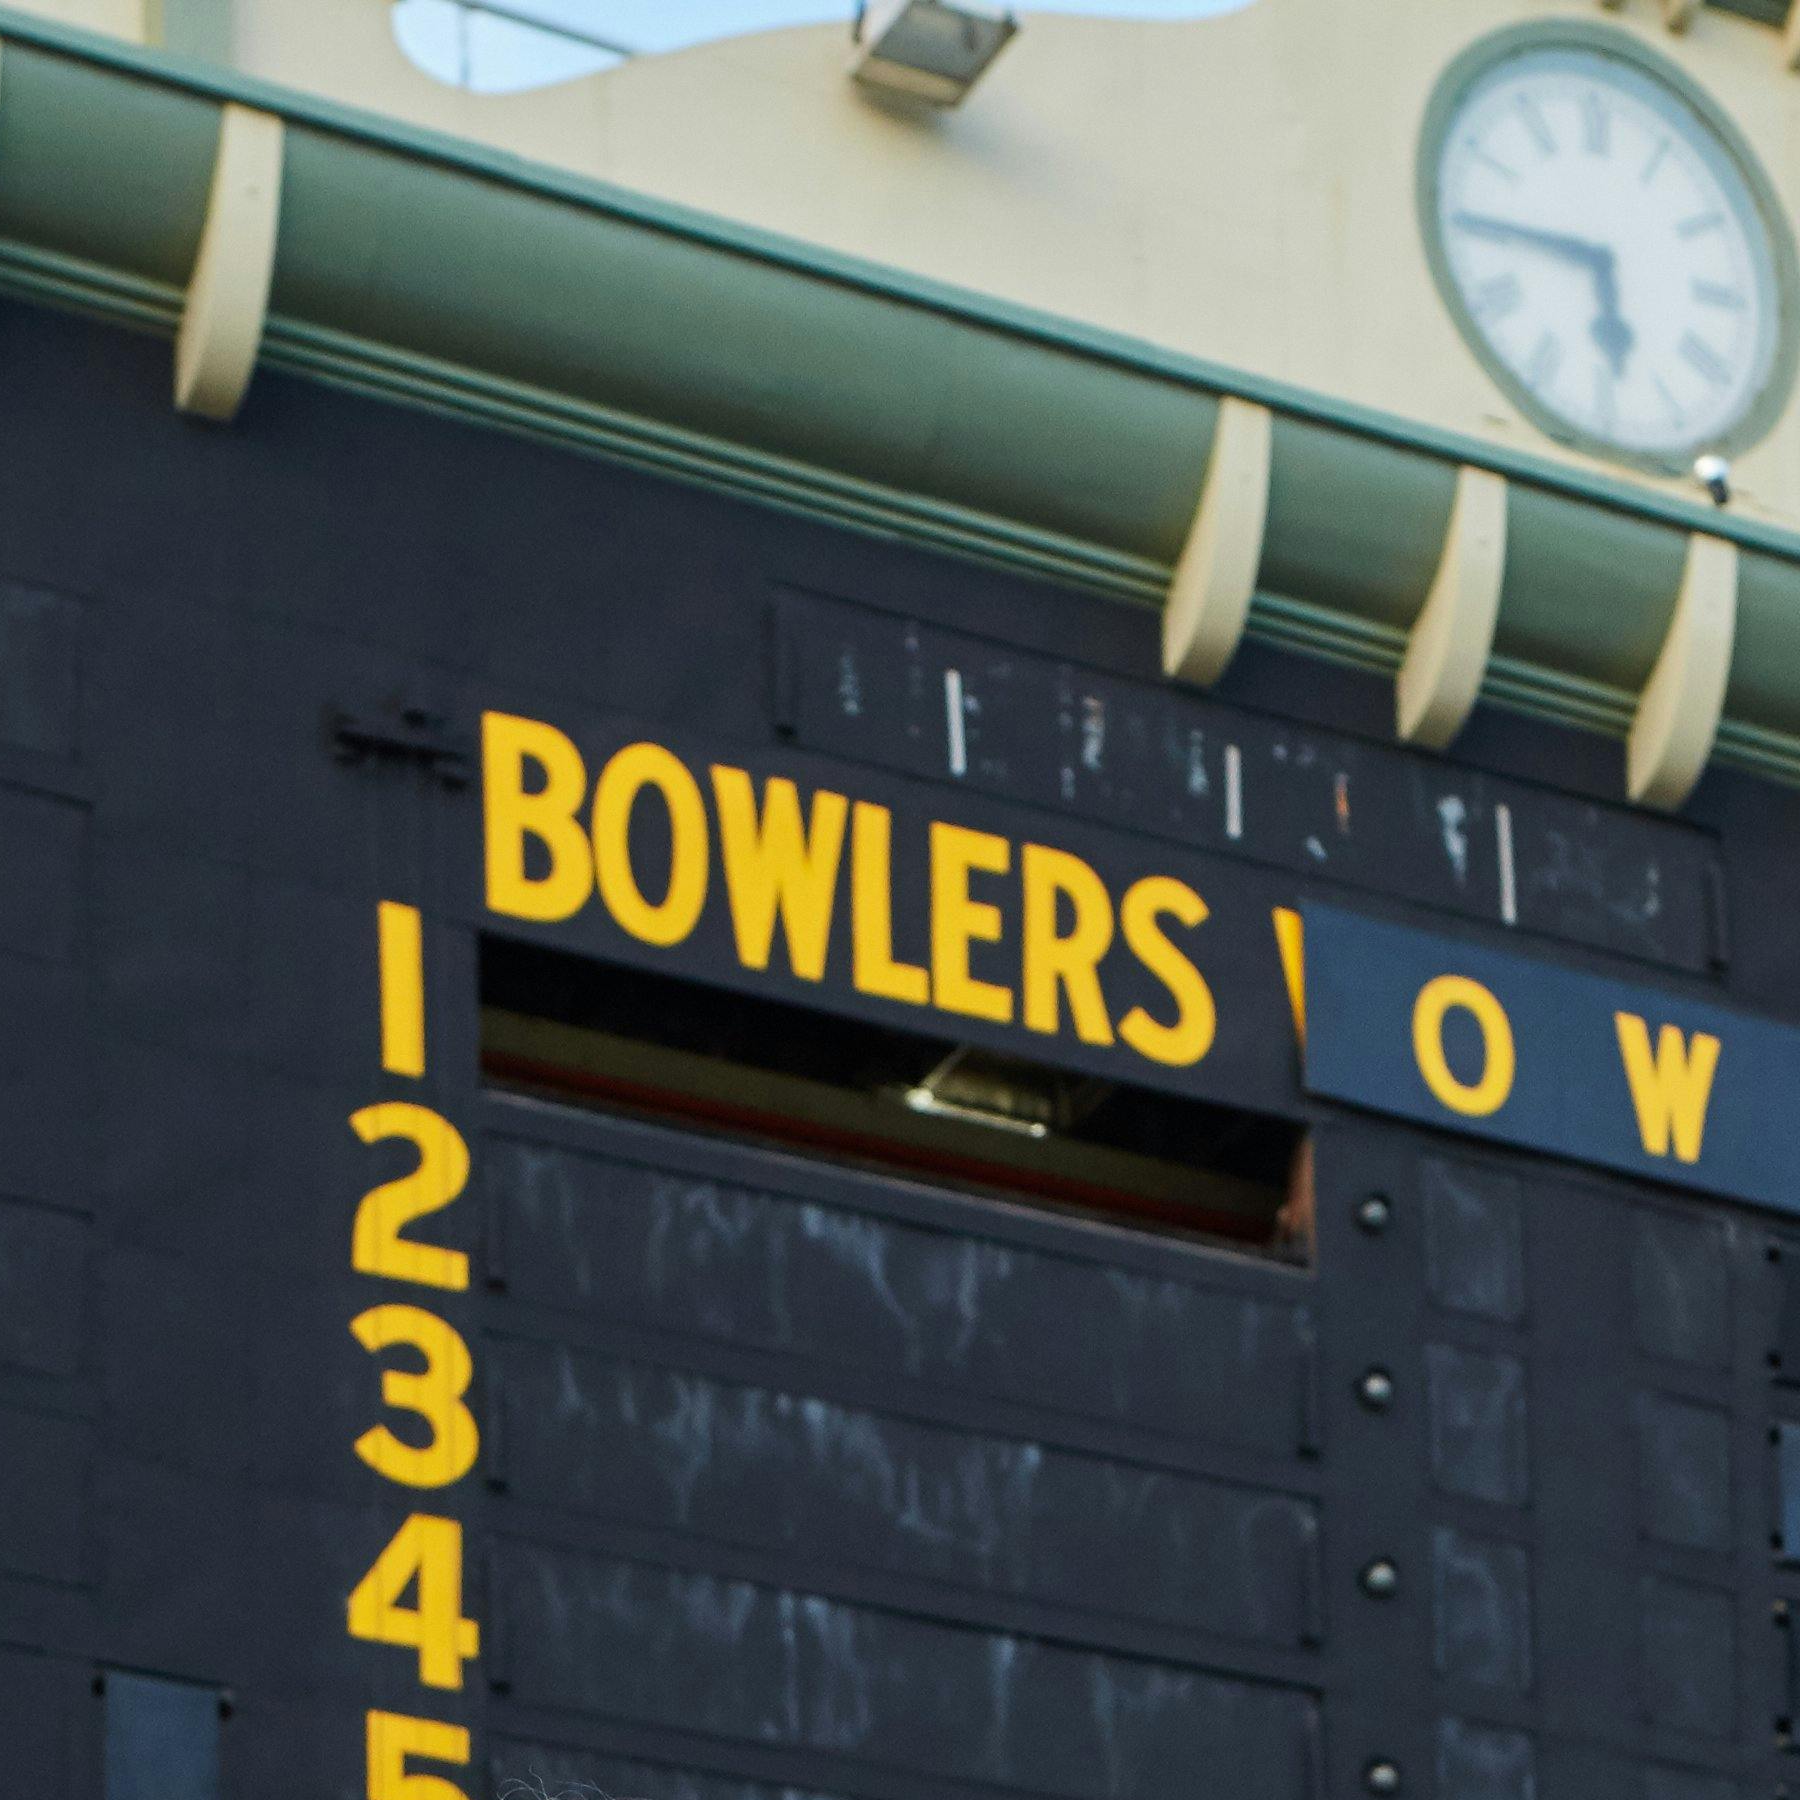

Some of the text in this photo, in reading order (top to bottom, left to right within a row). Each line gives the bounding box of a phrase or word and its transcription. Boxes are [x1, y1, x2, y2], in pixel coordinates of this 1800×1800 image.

[480, 710, 1217, 1067] BOWLERS
[377, 900, 426, 1078] 1
[1414, 978, 1513, 1115] O
[1614, 1013, 1723, 1165] W
[349, 1100, 470, 1292] 2
[348, 1303, 480, 1489] 3
[346, 1512, 480, 1690] 4
